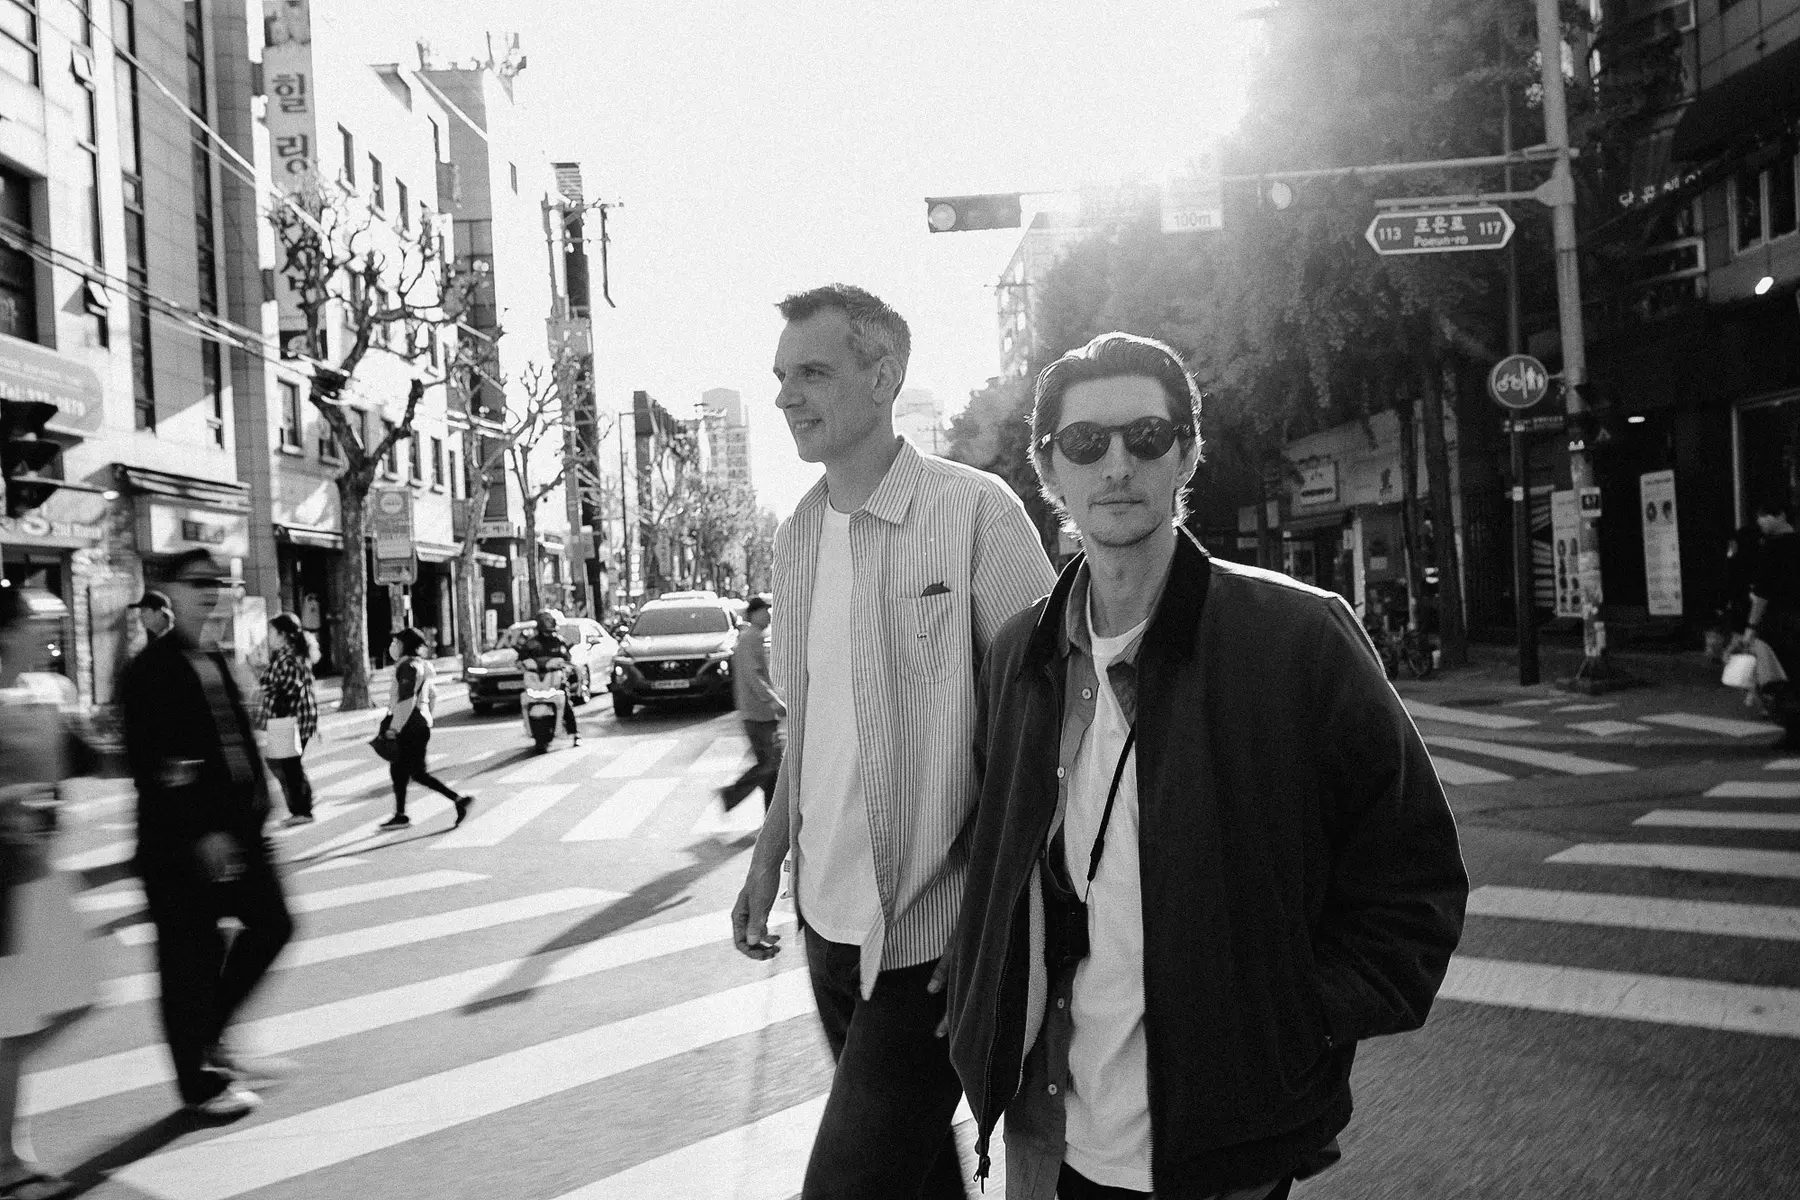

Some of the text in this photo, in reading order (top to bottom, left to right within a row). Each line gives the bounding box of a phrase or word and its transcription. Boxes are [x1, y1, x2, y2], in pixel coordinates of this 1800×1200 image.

[272, 73, 308, 175] 힐링
[1414, 216, 1467, 234] 포은로
[1479, 221, 1502, 236] 117
[1379, 226, 1402, 241] 113
